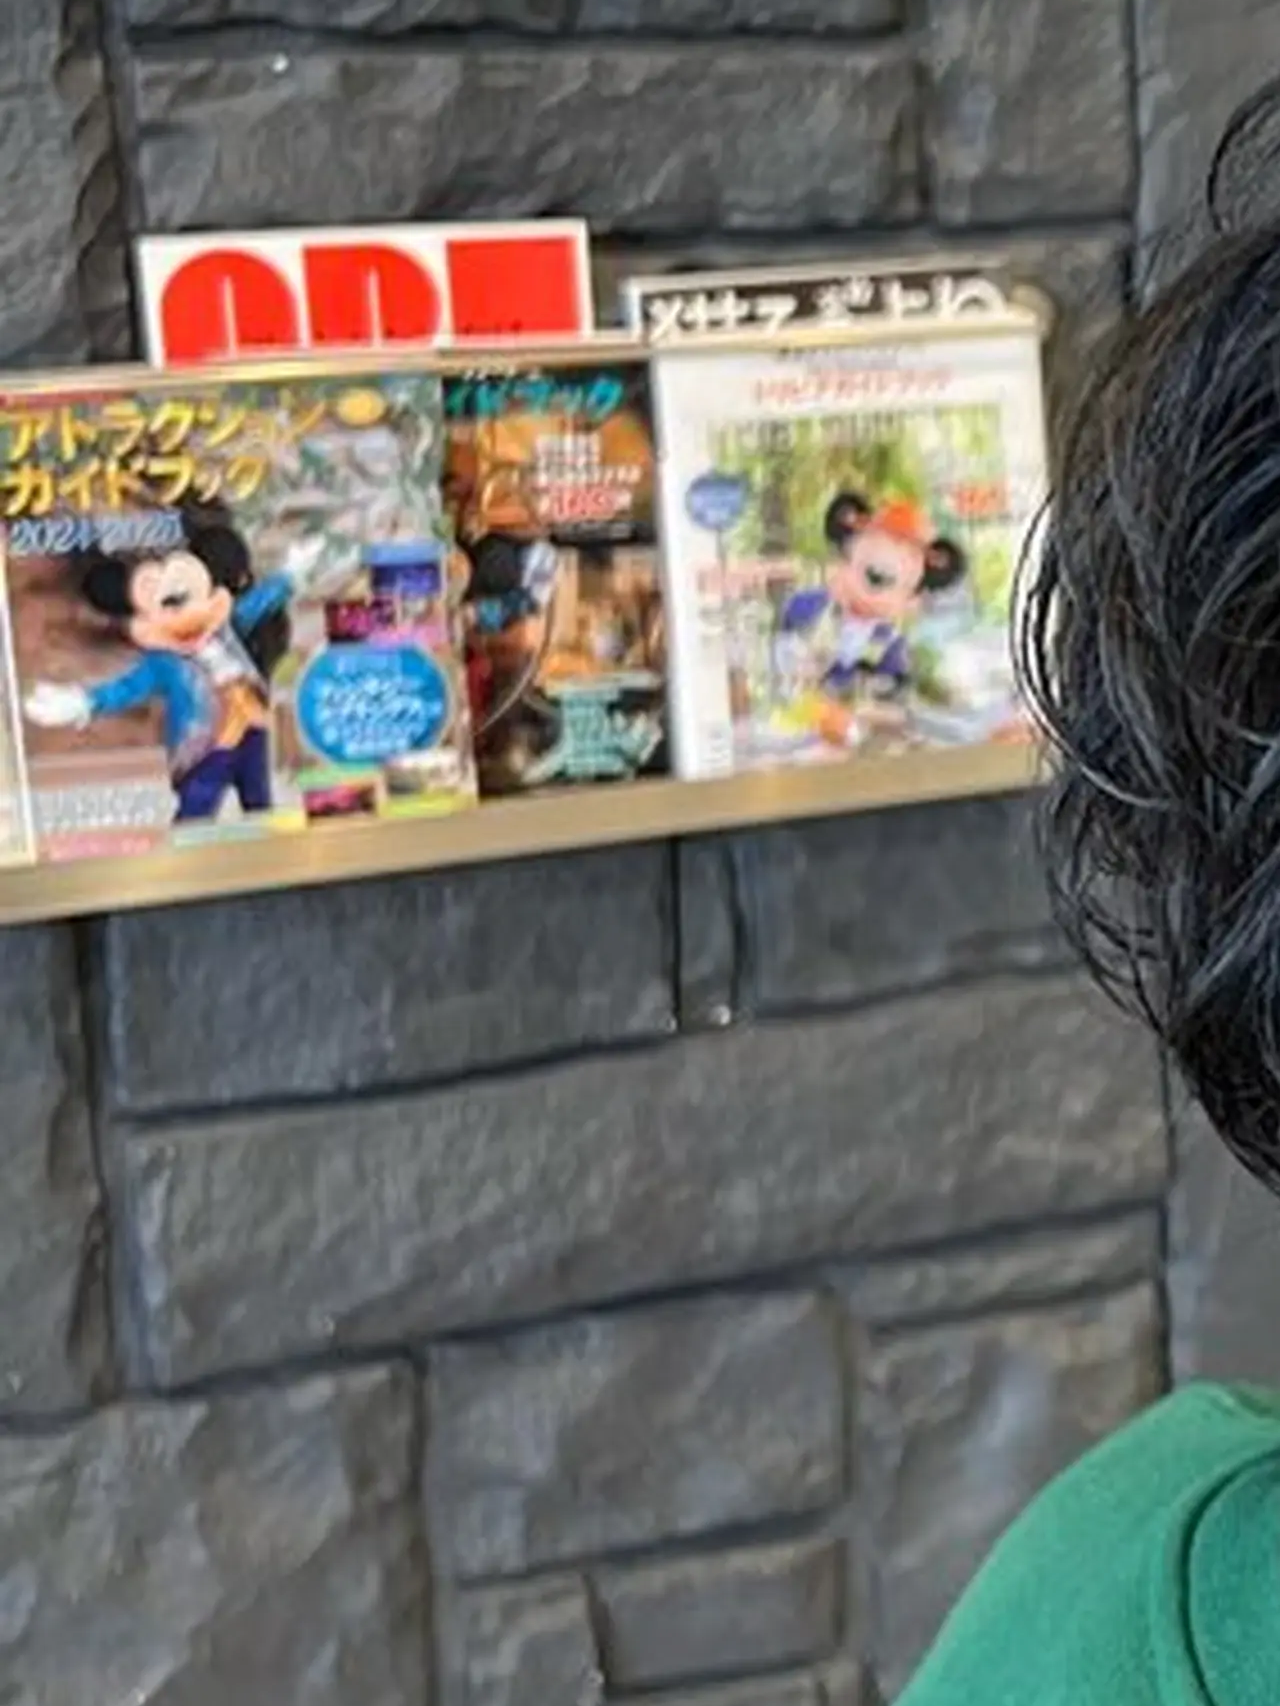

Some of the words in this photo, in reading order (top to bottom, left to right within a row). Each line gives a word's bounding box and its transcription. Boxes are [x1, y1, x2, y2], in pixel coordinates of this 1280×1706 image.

[2, 397, 327, 462] アトラクション
[2, 455, 268, 516] ガイドブック
